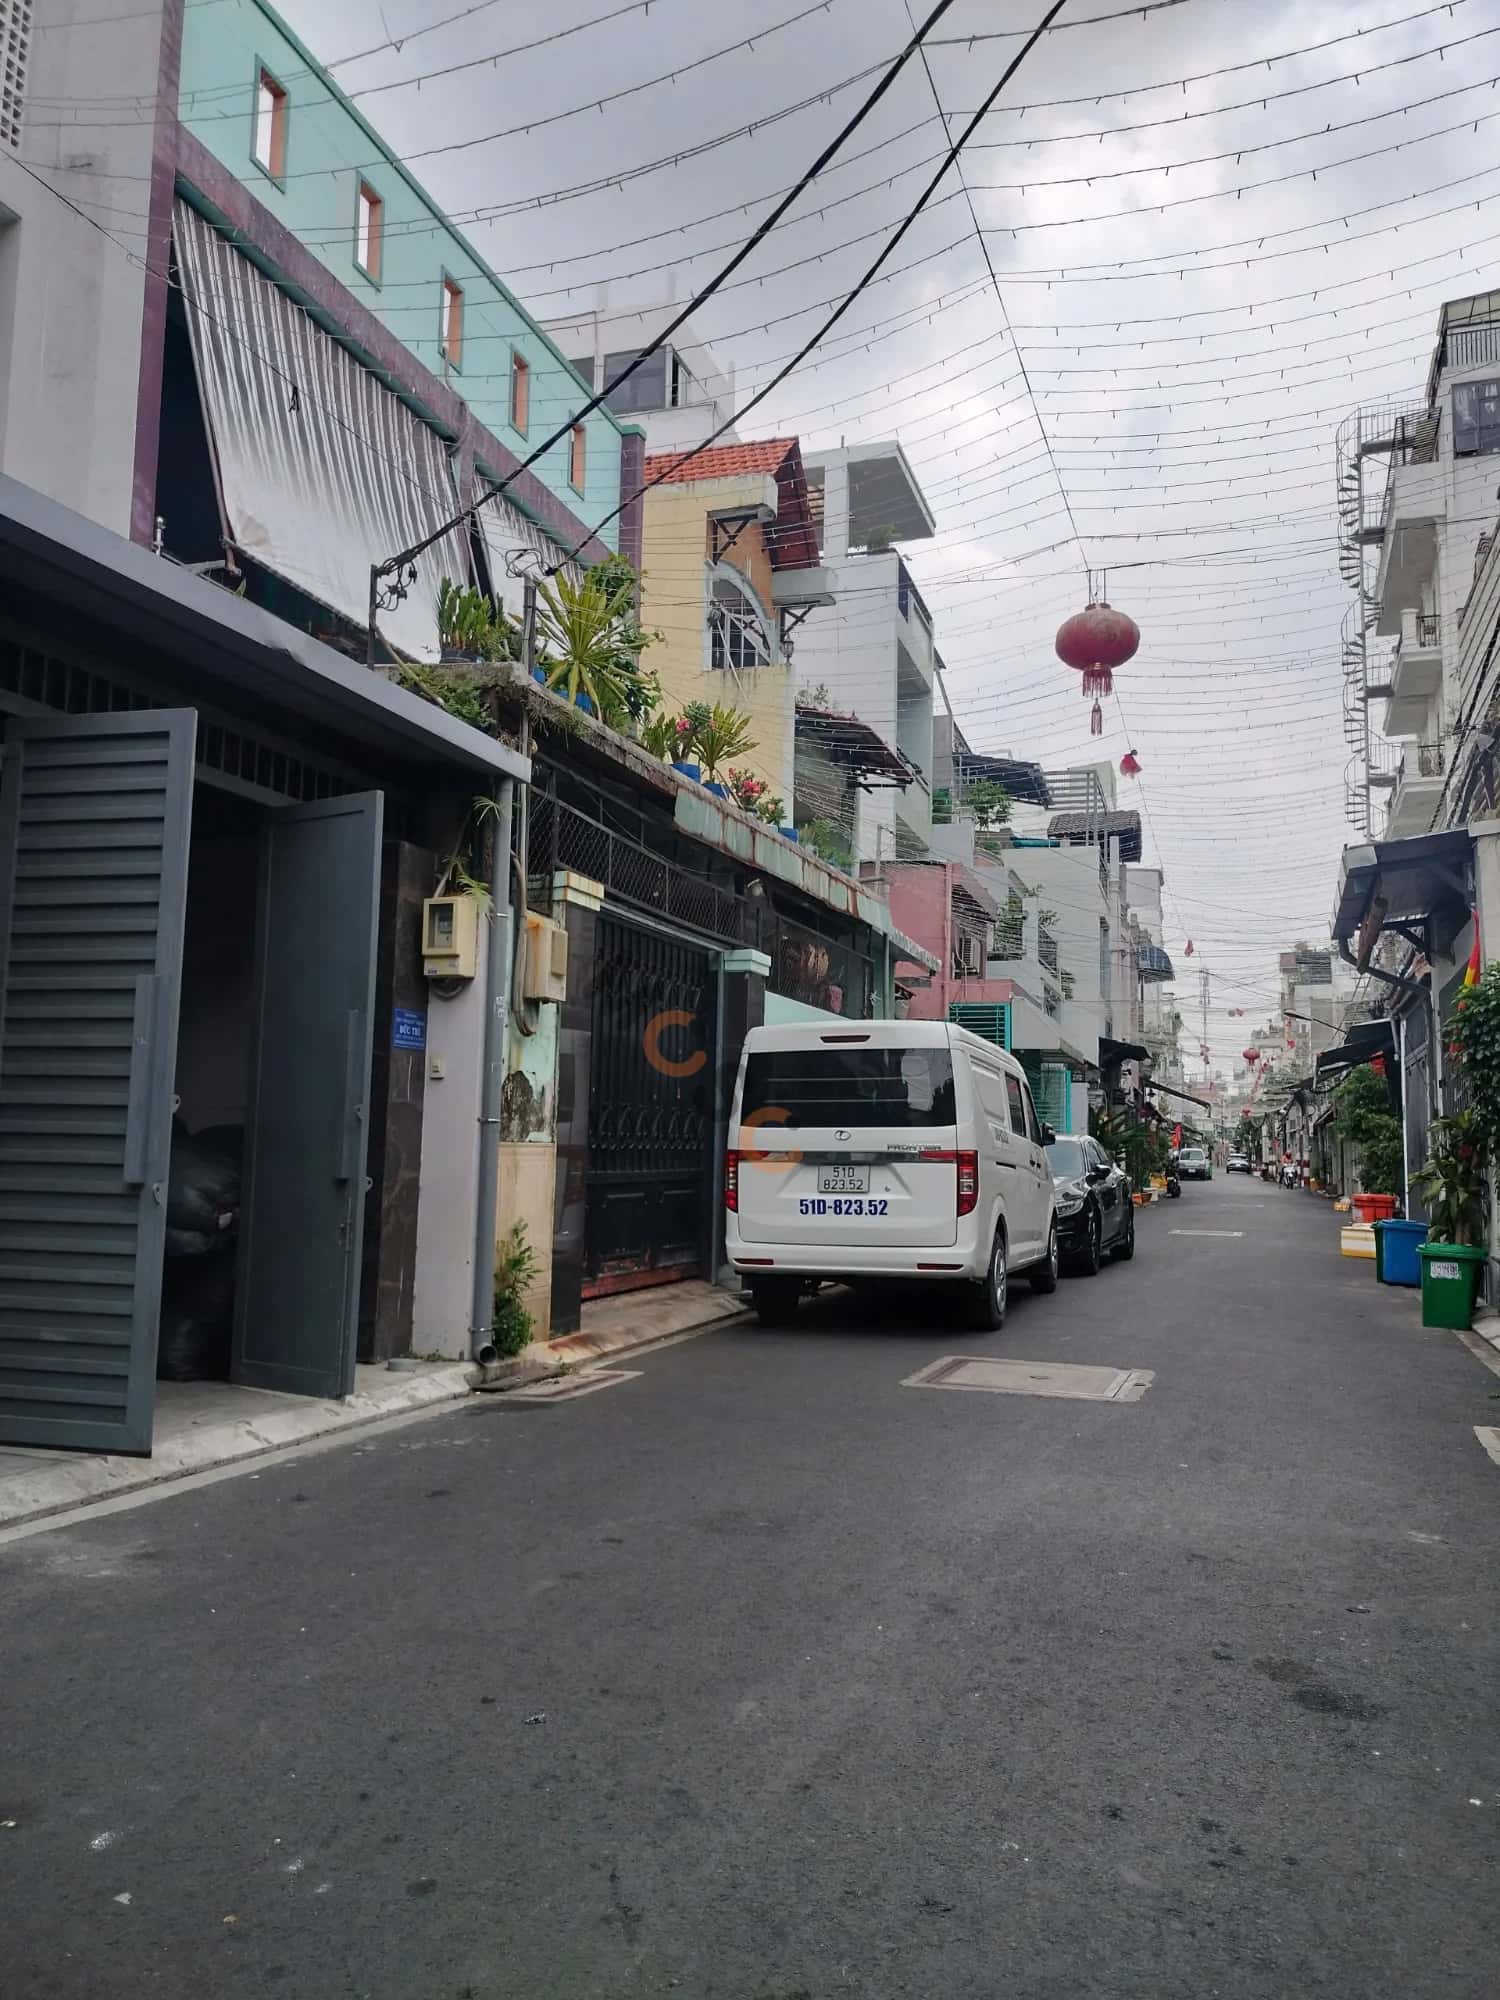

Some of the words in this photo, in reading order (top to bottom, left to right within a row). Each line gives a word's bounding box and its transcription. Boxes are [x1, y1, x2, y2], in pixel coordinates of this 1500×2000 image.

[832, 1166, 855, 1178] 51D
[823, 1179, 864, 1191] 823.52
[799, 1199, 888, 1216] 51D-823.52
